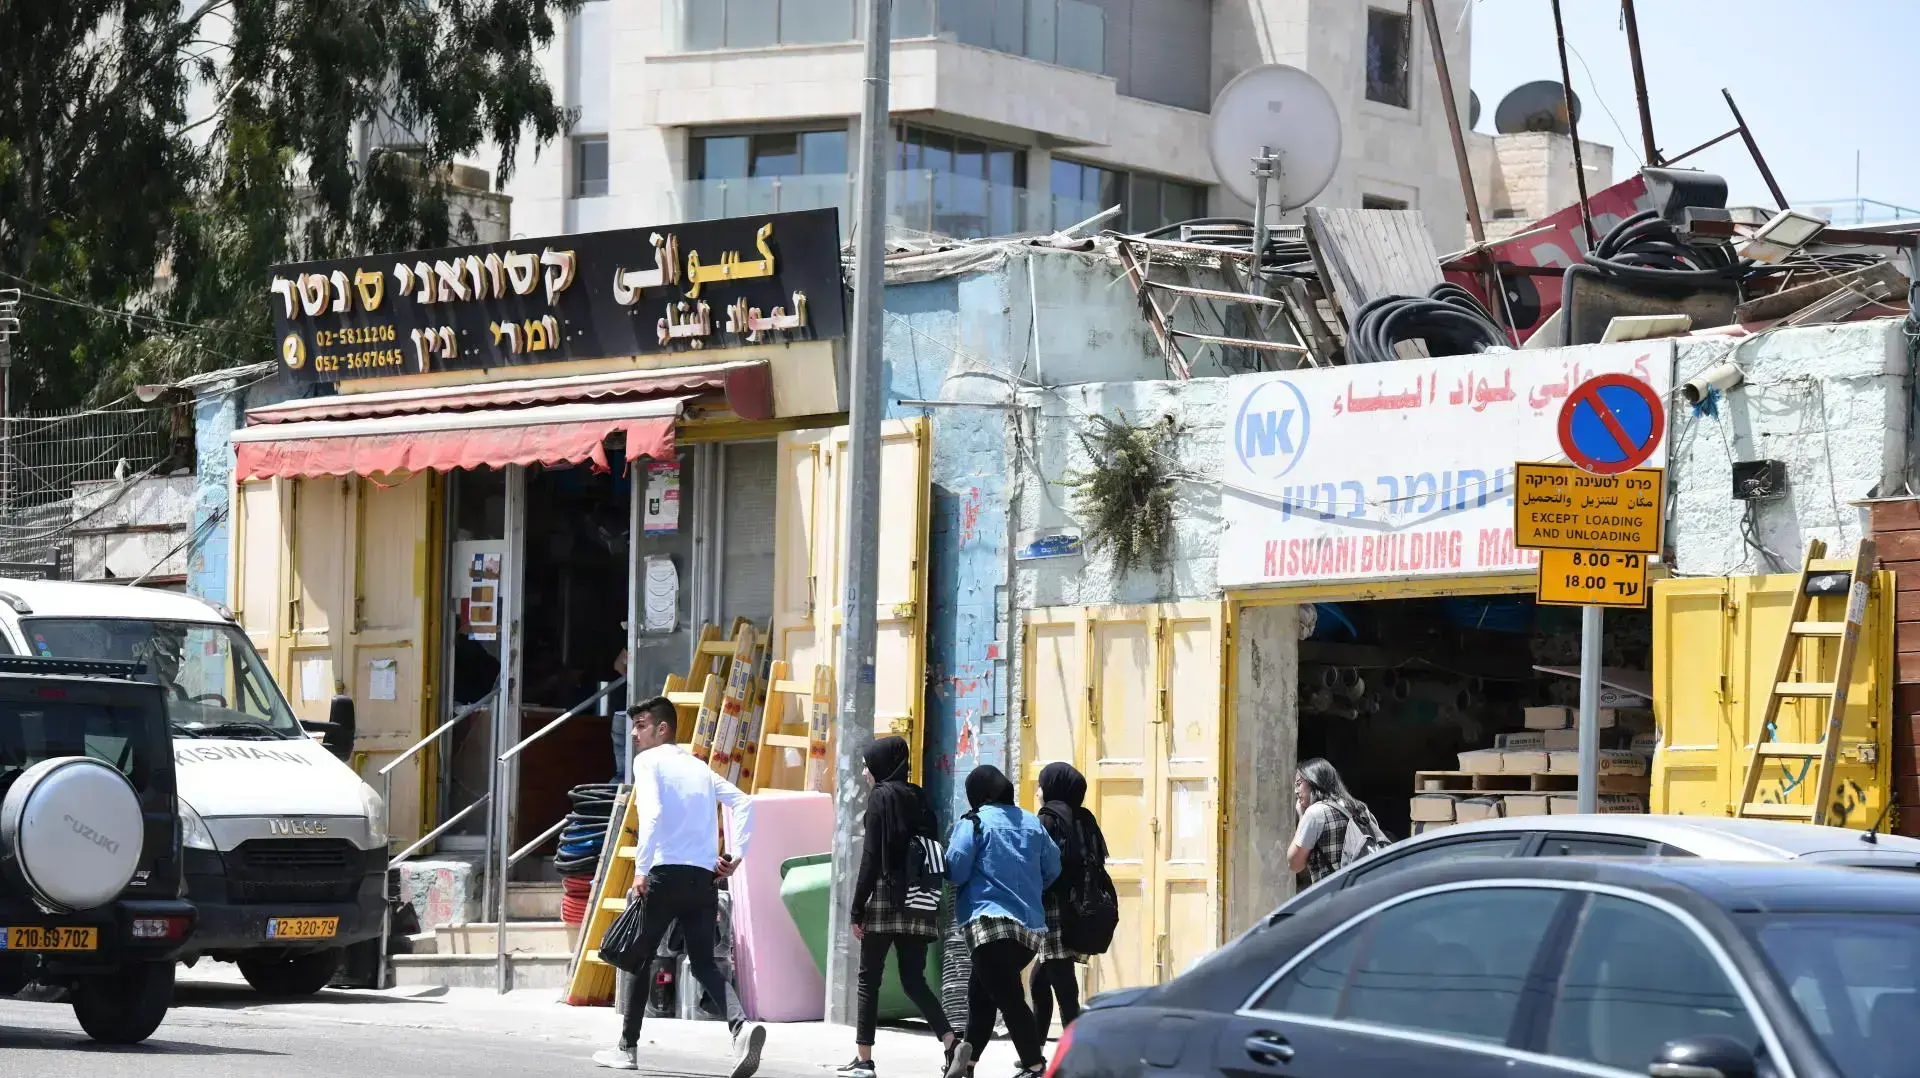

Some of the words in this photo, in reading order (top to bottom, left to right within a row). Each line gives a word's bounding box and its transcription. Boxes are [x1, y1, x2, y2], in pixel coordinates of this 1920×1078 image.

[271, 267, 385, 320] סנטר
[316, 325, 396, 347] 02-5811206
[315, 348, 403, 372] 052-3697645
[1332, 369, 1437, 420] البناء
[1449, 367, 1518, 413] لمواد
[1245, 409, 1296, 459] NK
[1525, 474, 1569, 488] ופריקה
[1574, 474, 1619, 488] לטעינה
[1625, 479, 1652, 490] פרט
[1376, 469, 1487, 514] חומר
[1627, 497, 1653, 510] مكان
[1531, 512, 1579, 524] EXCEPT
[1585, 515, 1643, 527] LOADING
[1533, 527, 1560, 539] AND
[1566, 530, 1641, 542] UNLOADING
[1263, 535, 1357, 577] KISWANI
[1360, 528, 1462, 573] BUILDING
[1565, 574, 1606, 589] 18.00
[1613, 581, 1639, 596] עד
[175, 746, 313, 767] KISWANI
[268, 818, 327, 836] IVECO
